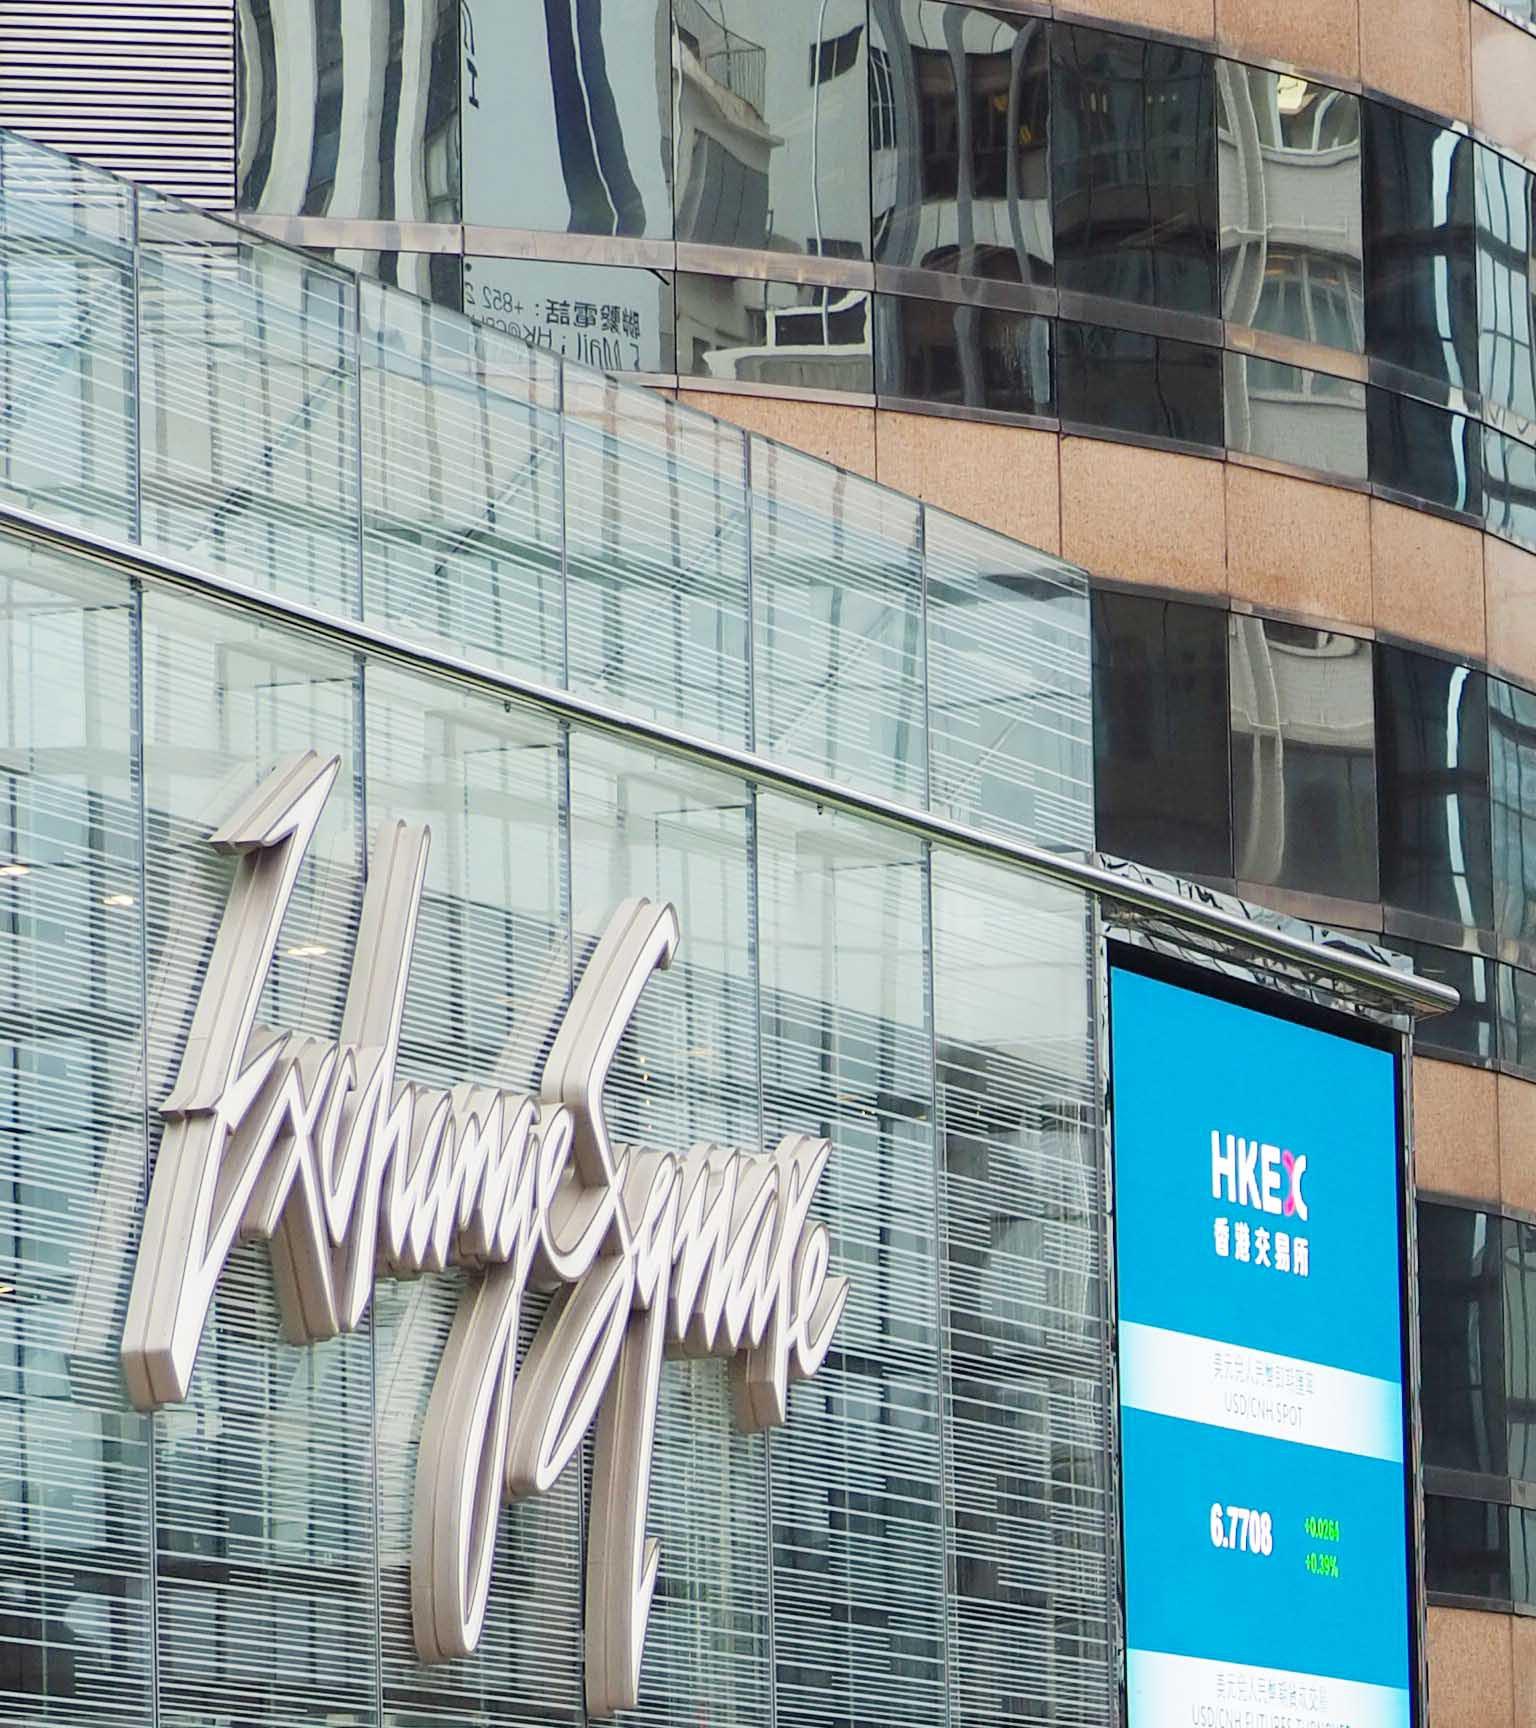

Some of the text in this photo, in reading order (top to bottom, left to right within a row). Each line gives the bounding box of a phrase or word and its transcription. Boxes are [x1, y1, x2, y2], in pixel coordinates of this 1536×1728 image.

[1210, 1129, 1309, 1222] HKEX
[120, 748, 850, 1719] Exchange Square
[1213, 1216, 1309, 1277] 香港交易所
[1209, 1502, 1273, 1556] 6.7708
